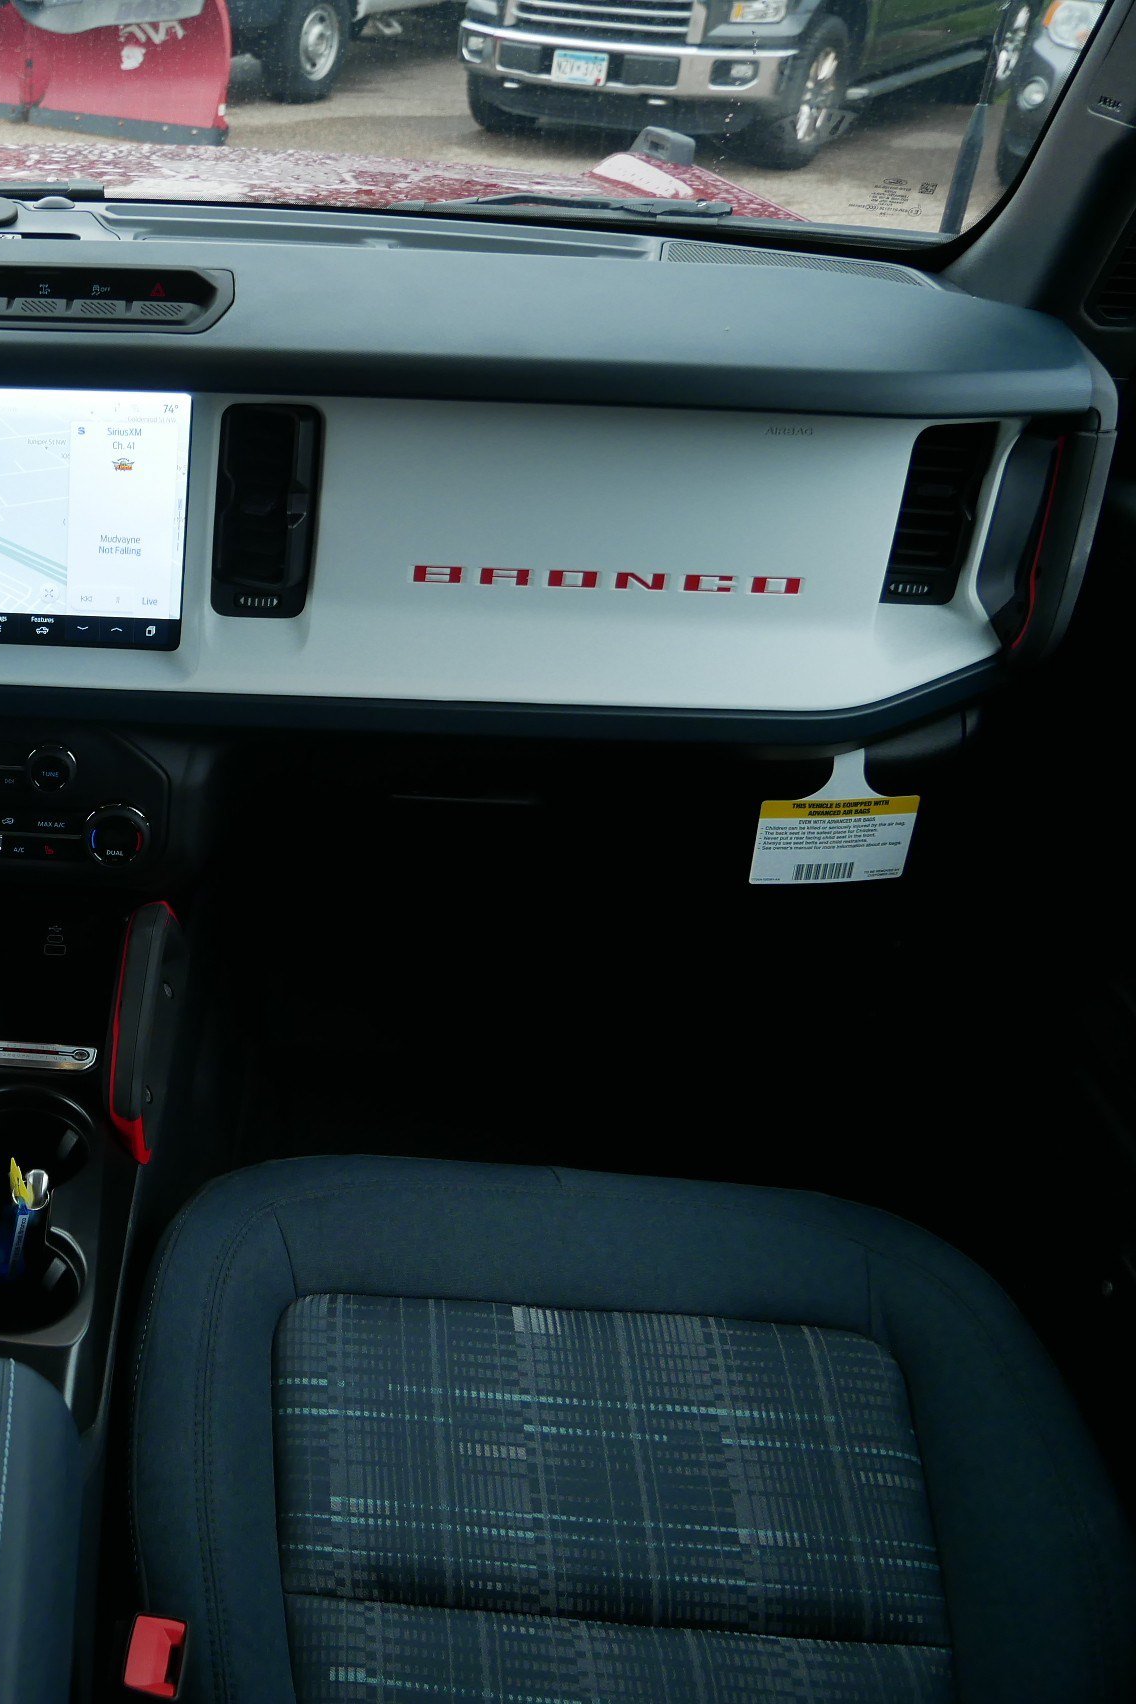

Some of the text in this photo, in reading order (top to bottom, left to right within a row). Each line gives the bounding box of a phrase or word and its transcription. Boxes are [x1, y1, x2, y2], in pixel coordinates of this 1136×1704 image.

[107, 427, 142, 437] SiriusXM
[126, 441, 135, 451] 41
[99, 535, 141, 546] Mudvayne
[98, 546, 141, 557] Not Falling
[411, 563, 806, 596] BRONCO
[142, 597, 158, 606] Live
[30, 616, 54, 624] Features
[37, 820, 52, 828] MAX
[106, 849, 123, 857] DUAL
